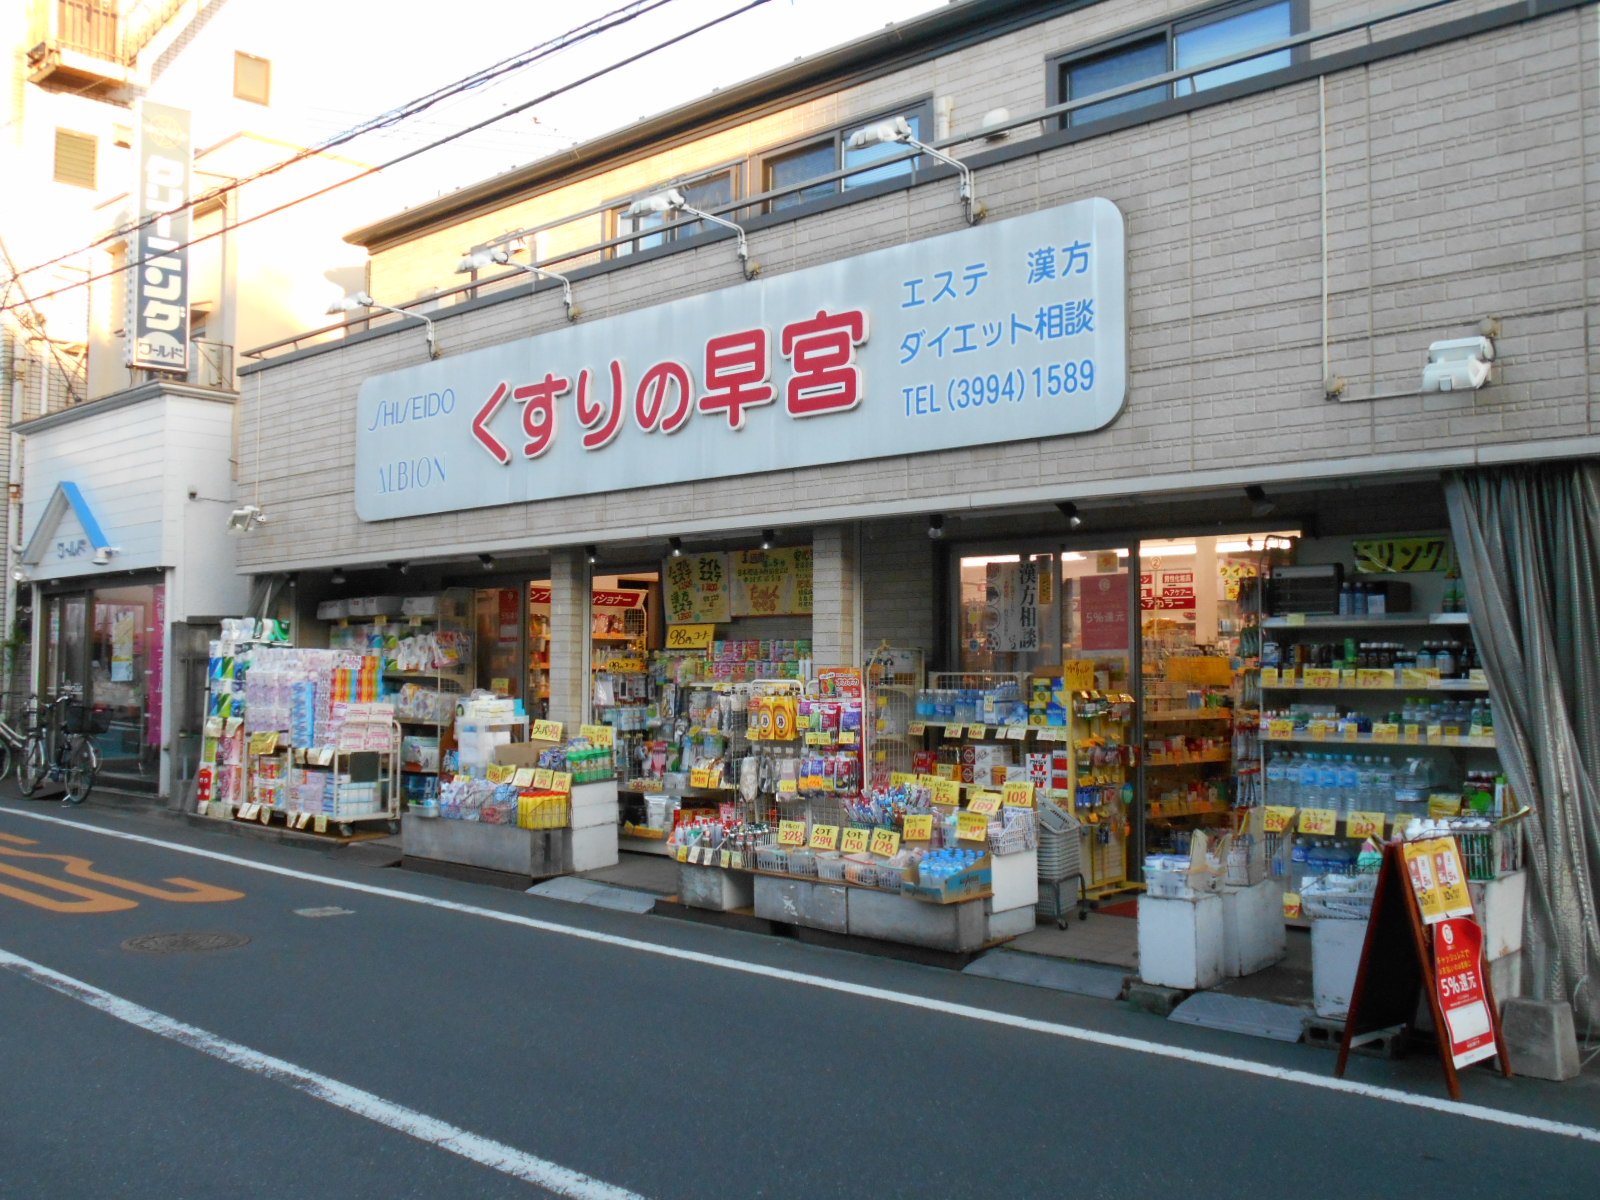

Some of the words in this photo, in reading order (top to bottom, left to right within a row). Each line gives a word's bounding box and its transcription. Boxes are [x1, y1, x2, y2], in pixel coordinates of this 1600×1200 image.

[901, 262, 989, 308] エステ
[1027, 239, 1091, 285] 漢方
[900, 299, 1095, 364] ダイエット相談
[471, 309, 869, 464] くすりの早宮
[368, 388, 455, 432] SHISEIDO
[377, 455, 447, 494] ALBION
[1353, 540, 1445, 571] ドリンク
[1019, 563, 1037, 649] 漢方相談
[815, 827, 832, 836] くつ下
[846, 830, 863, 839] くつ下
[877, 831, 894, 841] くつ下
[1440, 971, 1477, 997] 5%還元
